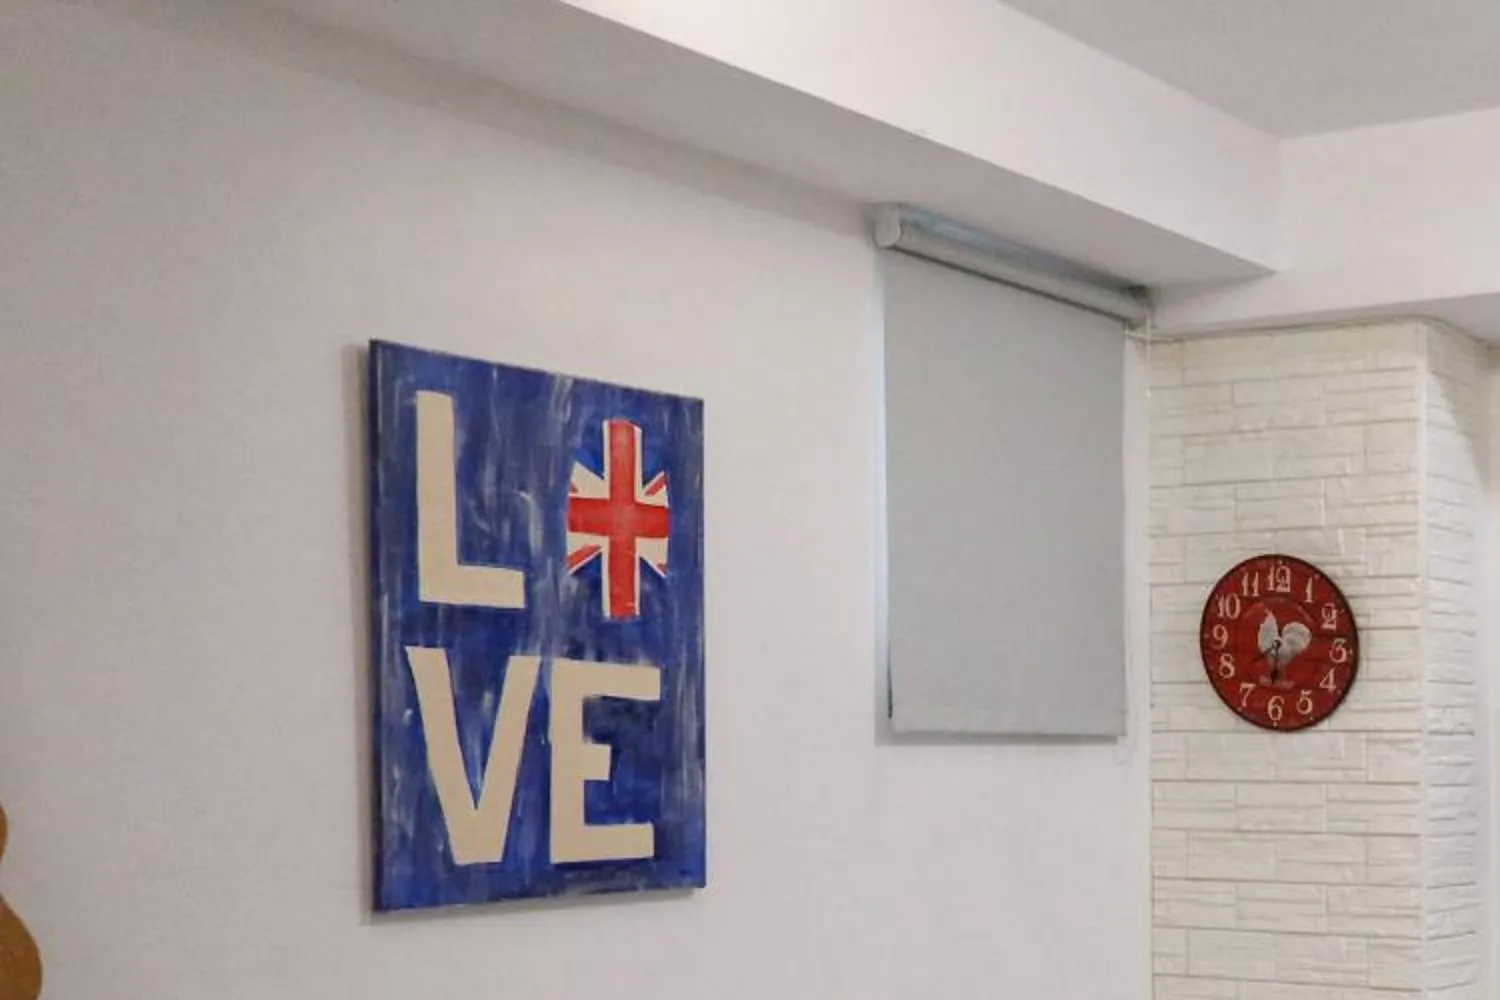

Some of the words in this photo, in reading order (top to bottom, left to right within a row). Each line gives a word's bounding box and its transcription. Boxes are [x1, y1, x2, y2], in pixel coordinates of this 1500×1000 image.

[1241, 571, 1260, 597] 11
[1267, 566, 1291, 593] 12
[1305, 577, 1314, 603] 1
[1217, 593, 1241, 619] 10
[1321, 603, 1337, 630] 2
[1212, 624, 1228, 649] 9
[1329, 638, 1347, 664] 3
[1219, 653, 1235, 679] 8
[1319, 667, 1337, 693] 4
[1239, 682, 1256, 708] 7
[1267, 695, 1285, 721] 6
[1296, 689, 1313, 715] 5
